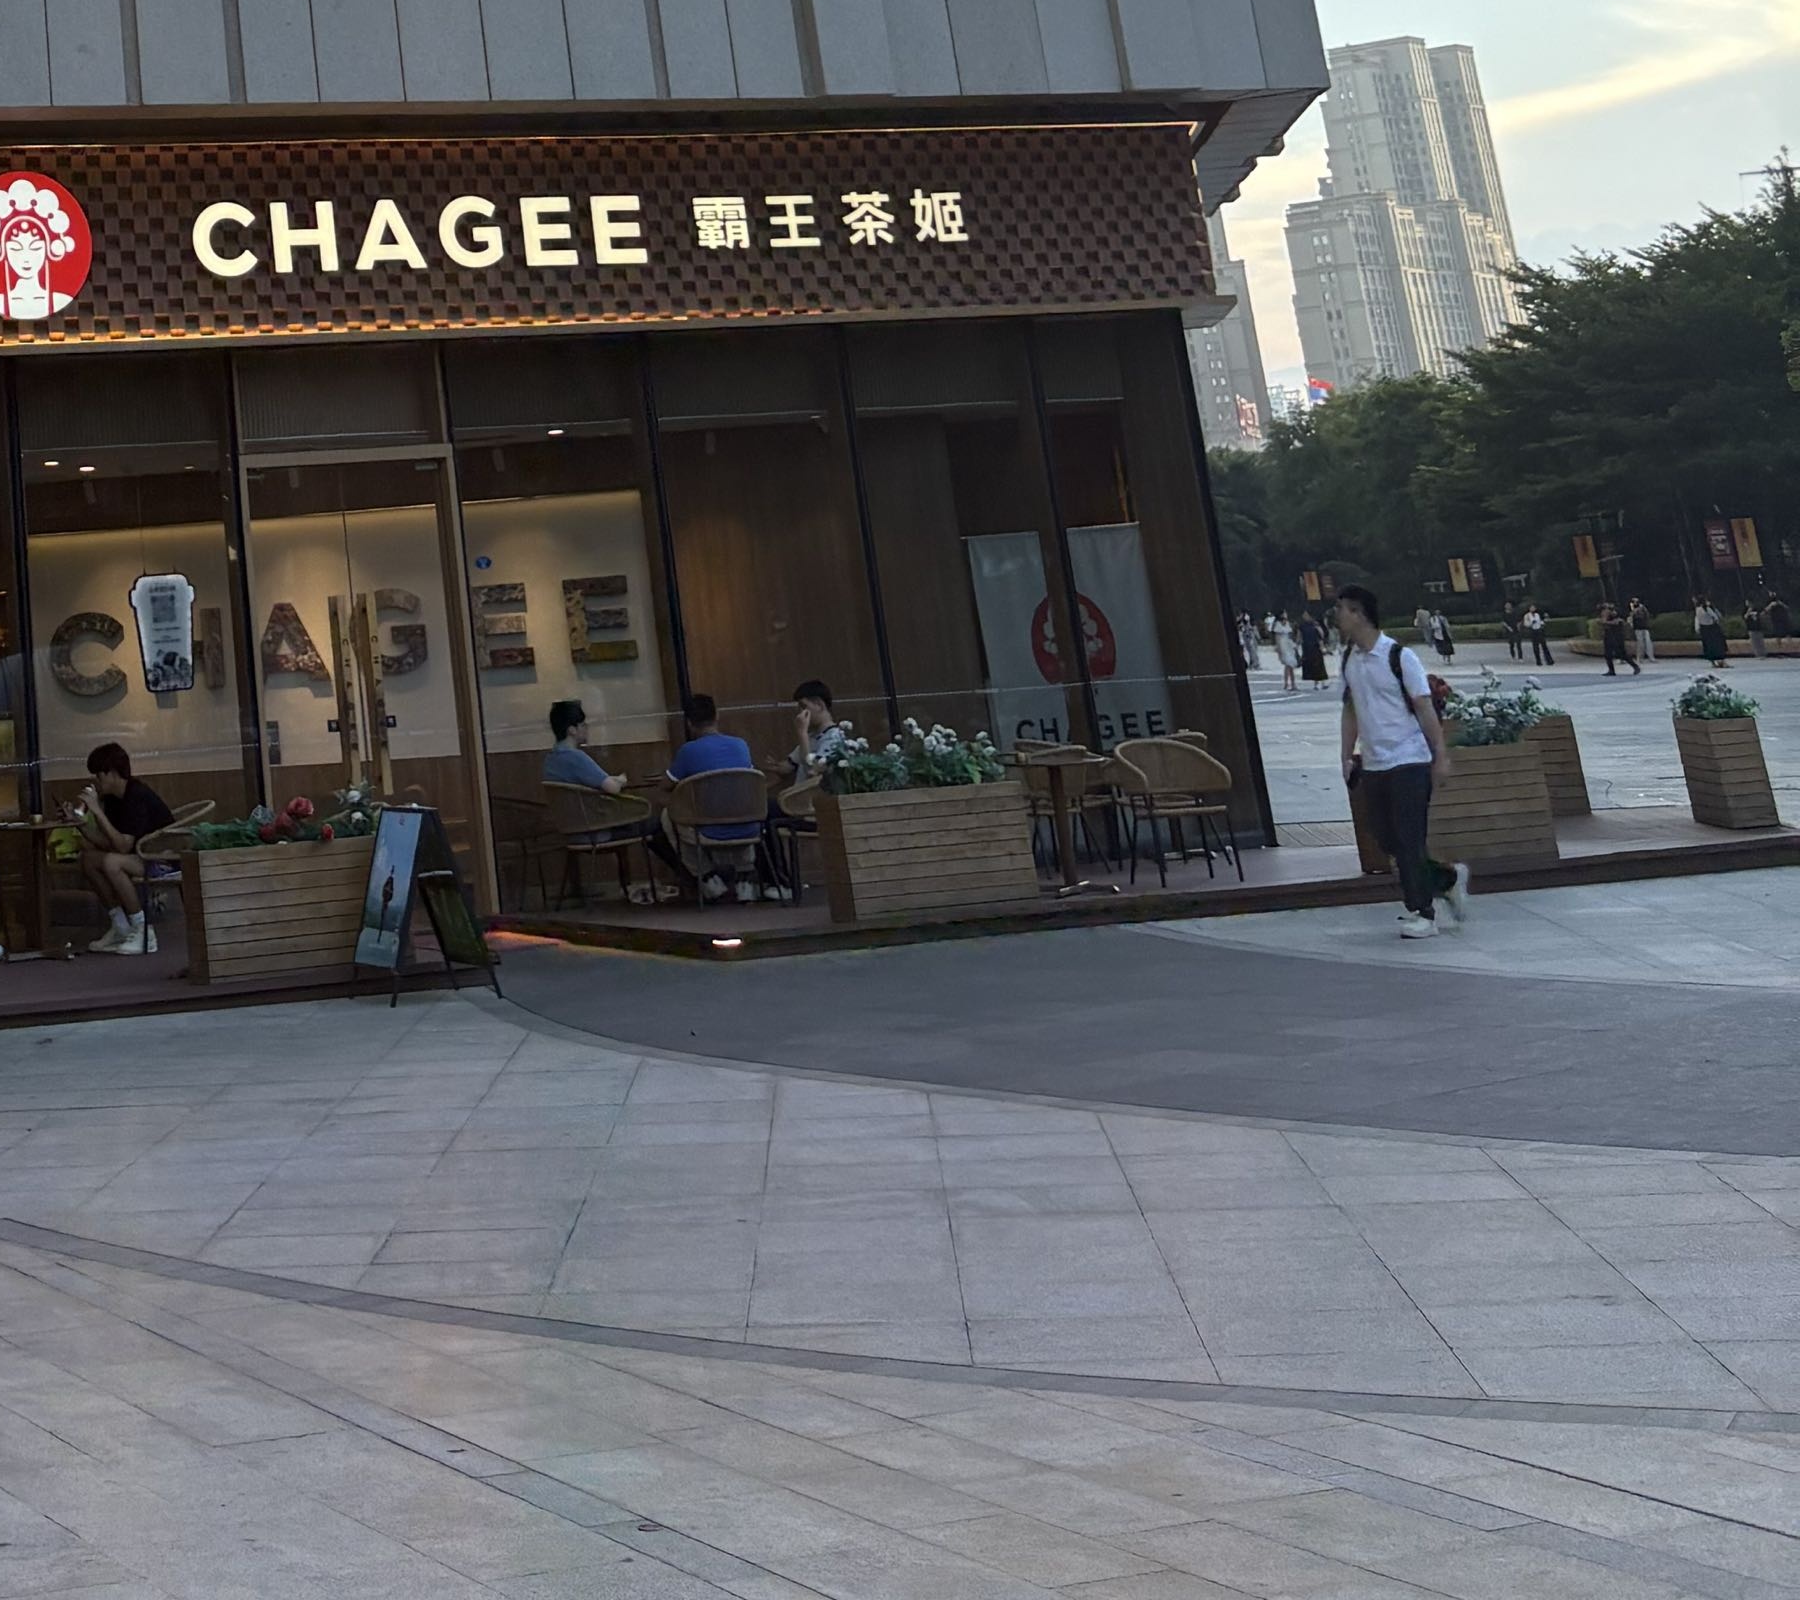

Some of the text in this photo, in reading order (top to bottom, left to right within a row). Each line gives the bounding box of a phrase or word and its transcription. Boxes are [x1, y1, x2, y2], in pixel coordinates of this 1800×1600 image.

[192, 188, 969, 277] CHAGEE 霸王茶姬
[1016, 710, 1167, 743] CHGEE
